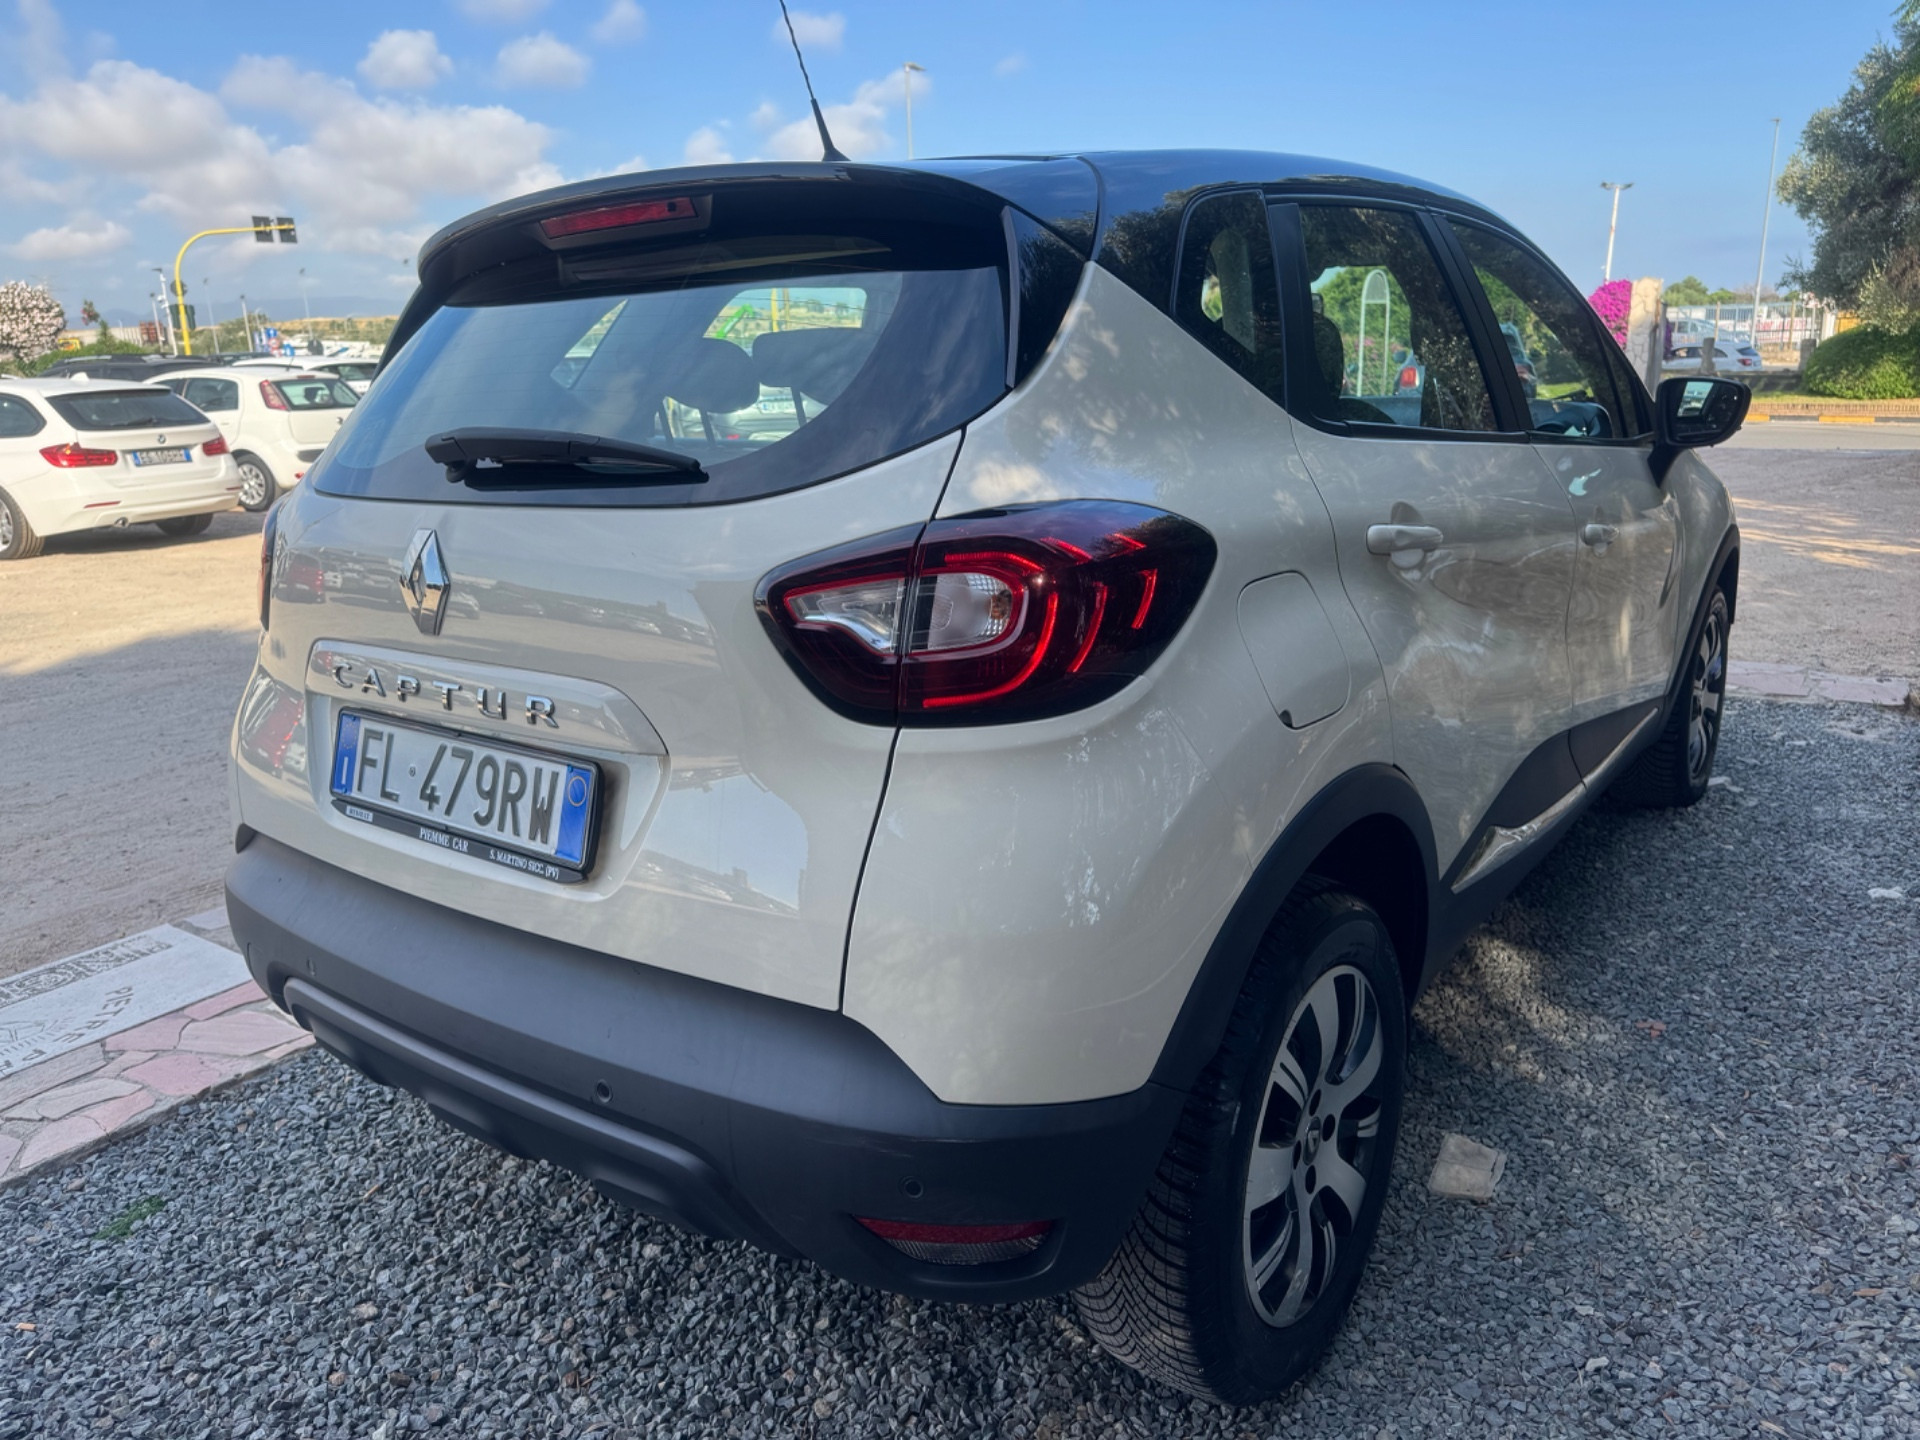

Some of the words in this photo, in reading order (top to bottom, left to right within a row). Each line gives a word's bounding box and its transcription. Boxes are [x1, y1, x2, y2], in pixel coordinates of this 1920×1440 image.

[332, 662, 560, 728] CAPTUR
[357, 726, 400, 803] FL
[419, 742, 560, 845] 479RW
[419, 826, 450, 848] PIEMME
[452, 836, 469, 853] CAR
[496, 850, 528, 869] MARTINO
